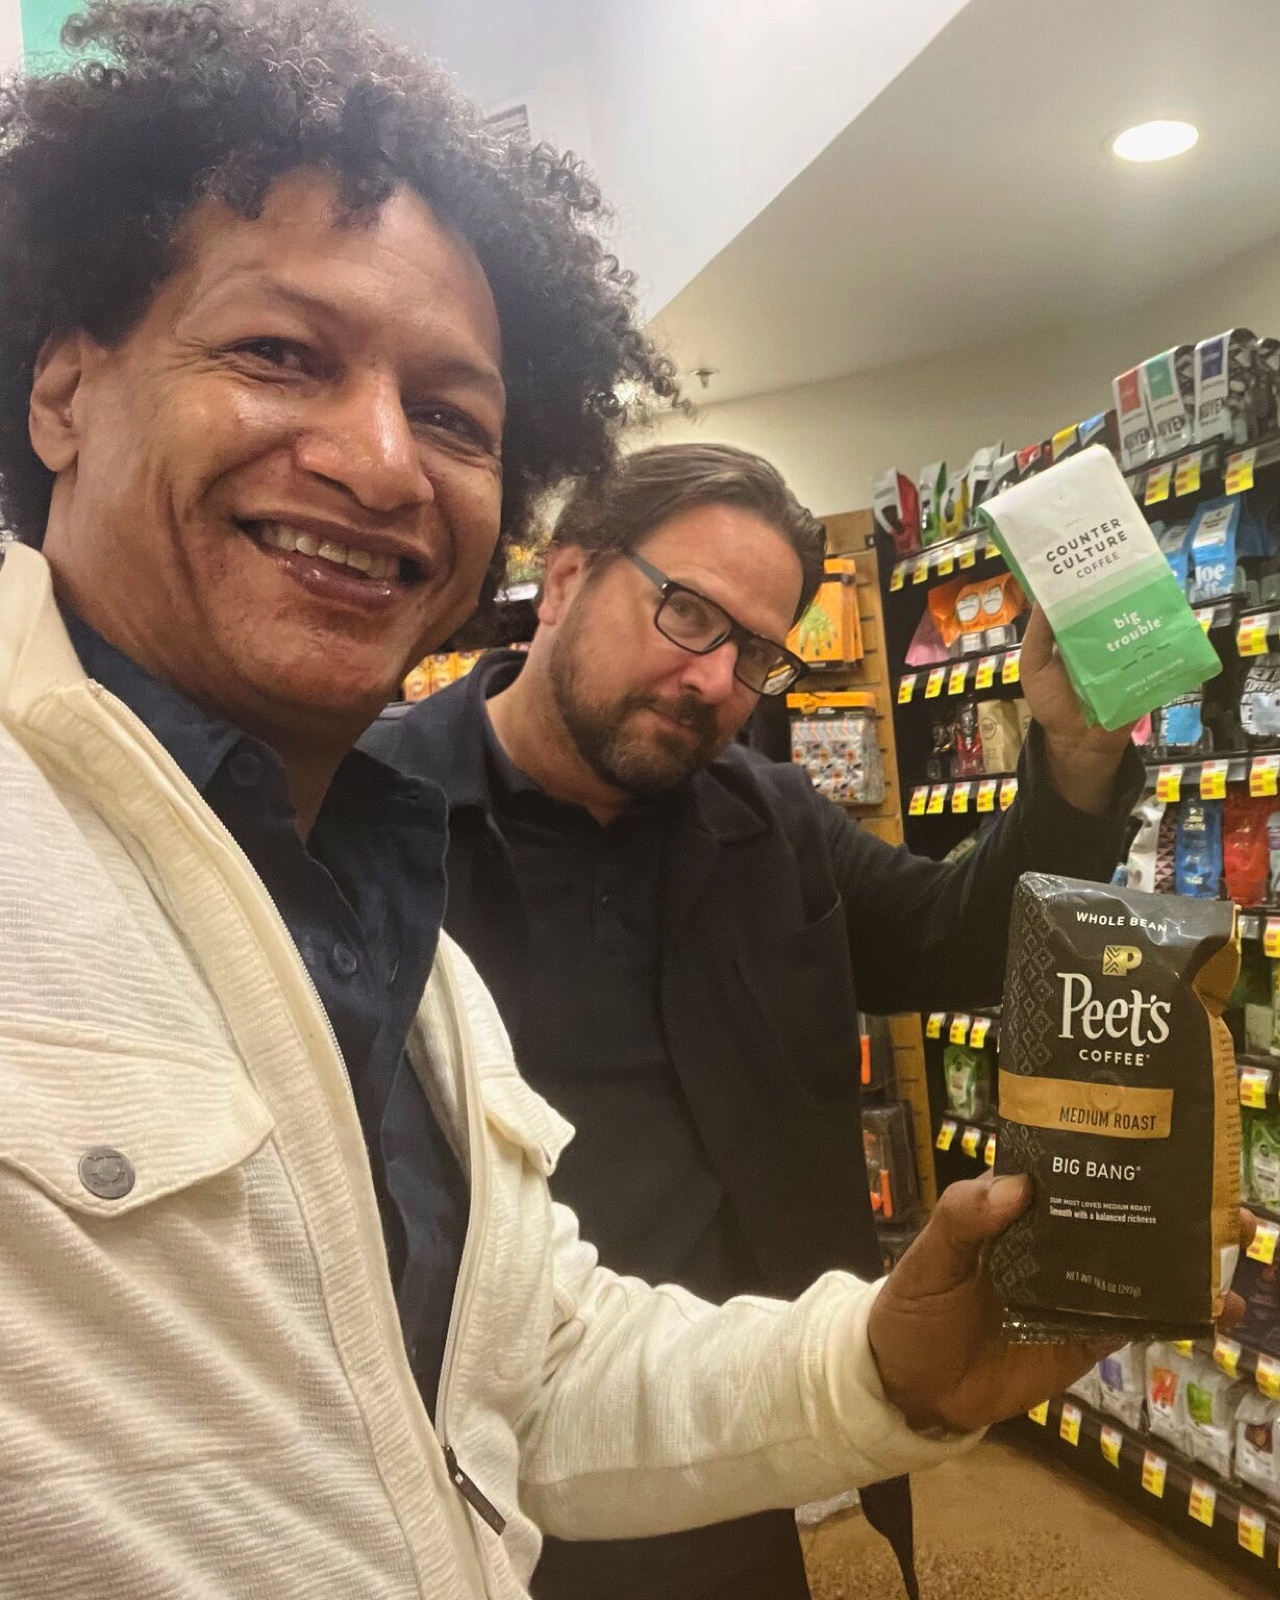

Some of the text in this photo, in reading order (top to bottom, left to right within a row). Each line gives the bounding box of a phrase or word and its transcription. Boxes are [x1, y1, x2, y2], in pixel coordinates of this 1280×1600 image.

[1046, 518, 1121, 562] COUNTER
[1052, 530, 1128, 575] CULTURE
[1076, 551, 1120, 578] COFFEE
[1113, 611, 1141, 629] big
[1106, 617, 1162, 652] trouble
[1076, 911, 1126, 926] WHOLE
[1129, 916, 1168, 932] BEAN
[1056, 972, 1171, 1047] Peet's
[1079, 1049, 1145, 1067] COFFEE
[1059, 1106, 1157, 1131] MEDIUM ROAST
[1052, 1156, 1136, 1181] BIG BANG
[1050, 1196, 1152, 1212] OUR MOST LOVED MEDIUM ROAST
[1095, 1211, 1126, 1223] balanced
[1127, 1214, 1157, 1224] richness
